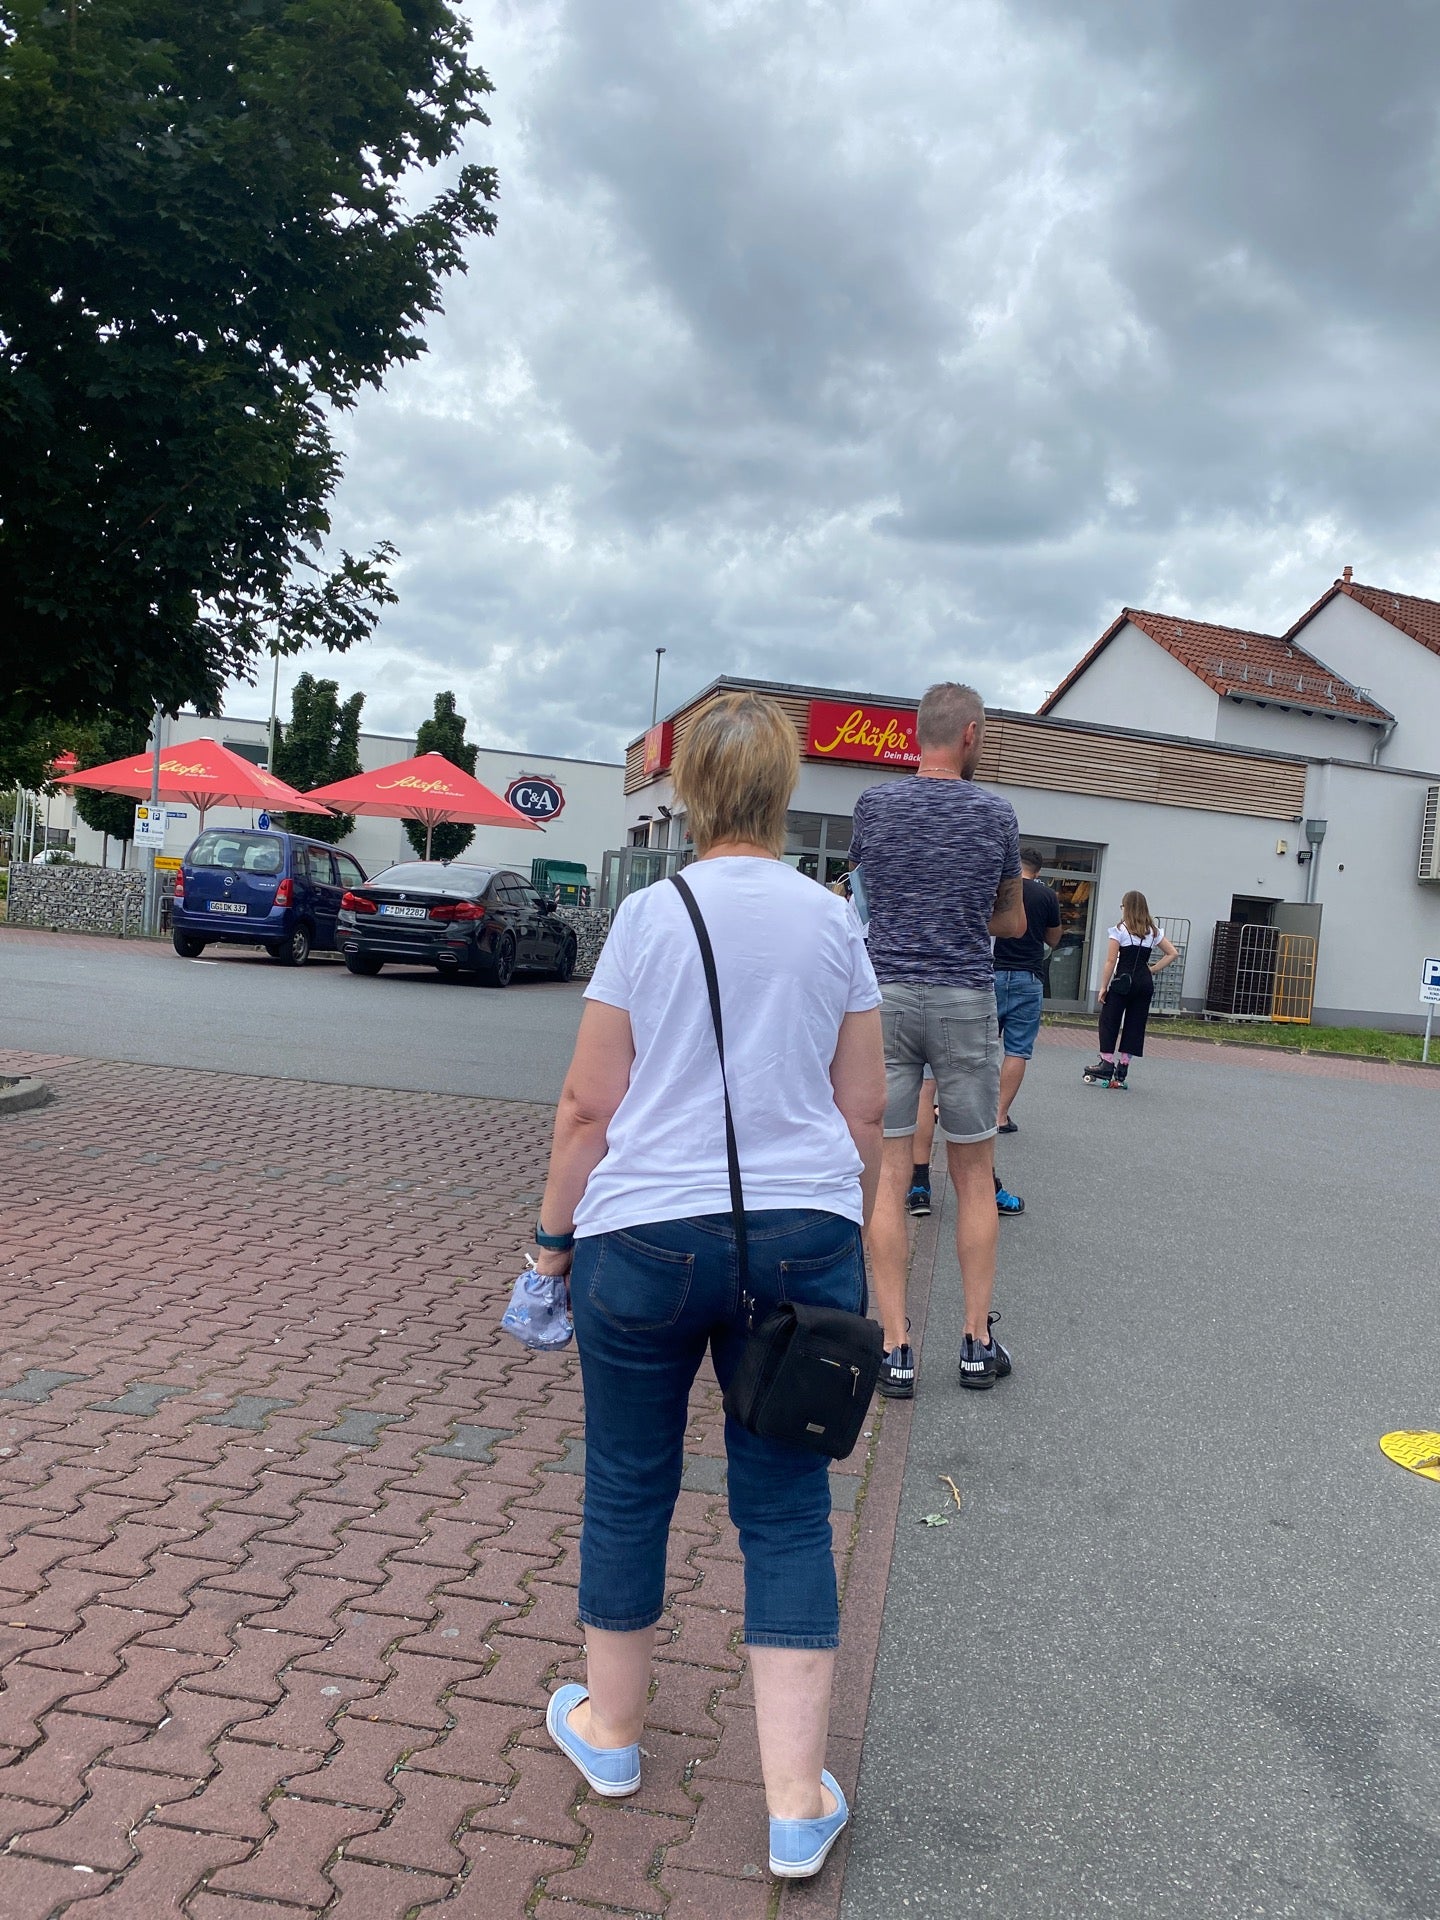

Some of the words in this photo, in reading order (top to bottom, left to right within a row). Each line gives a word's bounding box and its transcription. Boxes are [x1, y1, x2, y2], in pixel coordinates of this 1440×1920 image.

[814, 709, 908, 756] Schäfer
[884, 750, 901, 760] Dein
[903, 752, 922, 762] Bäck
[516, 788, 555, 811] C&A
[210, 902, 219, 910] GG
[233, 904, 246, 913] 337
[406, 908, 424, 917] 2282
[960, 1360, 985, 1372] PUMA
